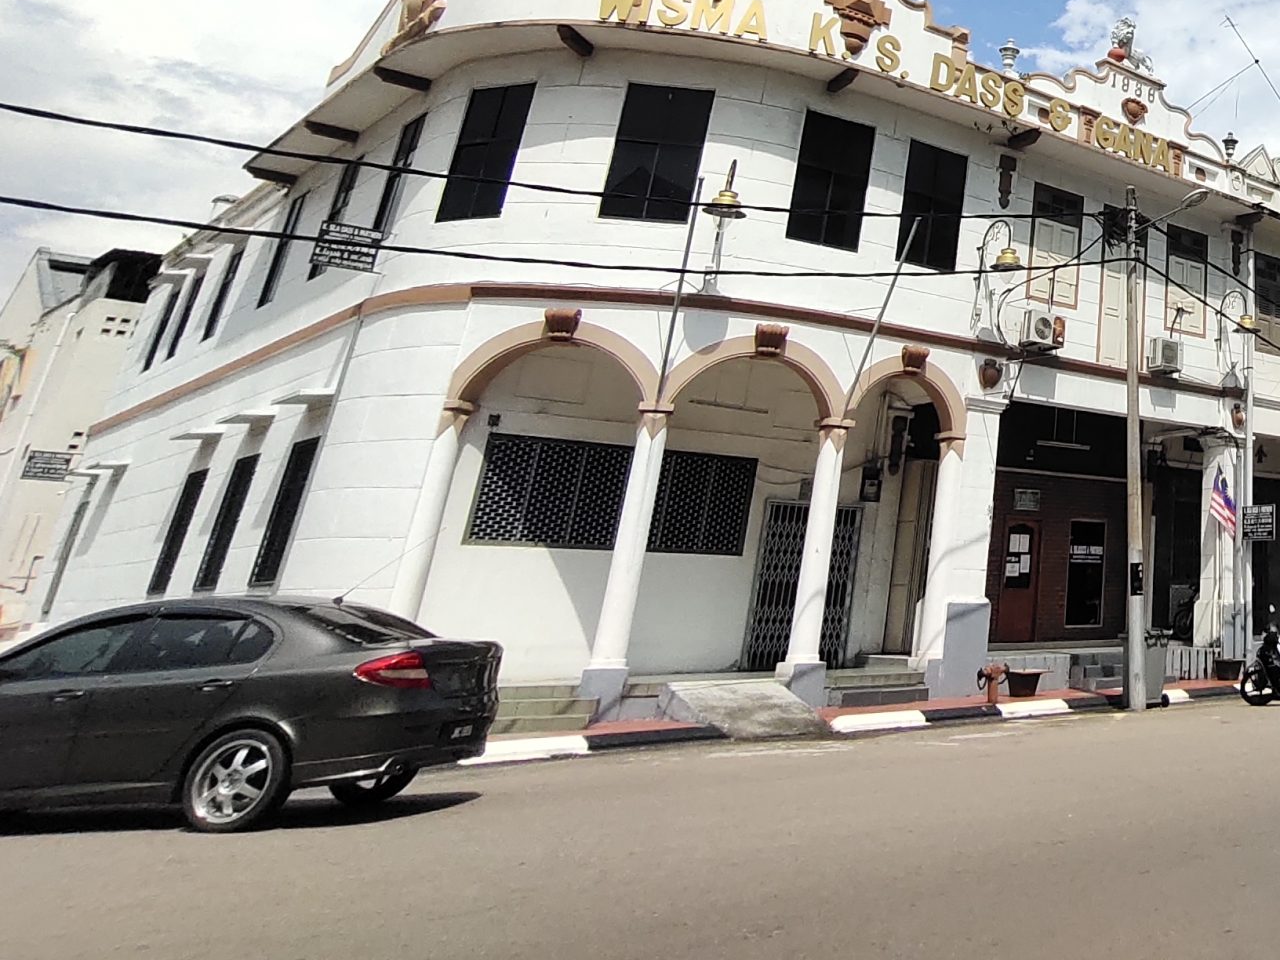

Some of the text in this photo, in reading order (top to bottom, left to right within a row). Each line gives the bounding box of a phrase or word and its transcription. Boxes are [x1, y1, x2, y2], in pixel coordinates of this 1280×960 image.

[808, 12, 851, 60] K.
[875, 34, 909, 79] S.
[929, 52, 1025, 117] DASS
[1049, 98, 1073, 131] &
[1095, 115, 1171, 172] GANA
